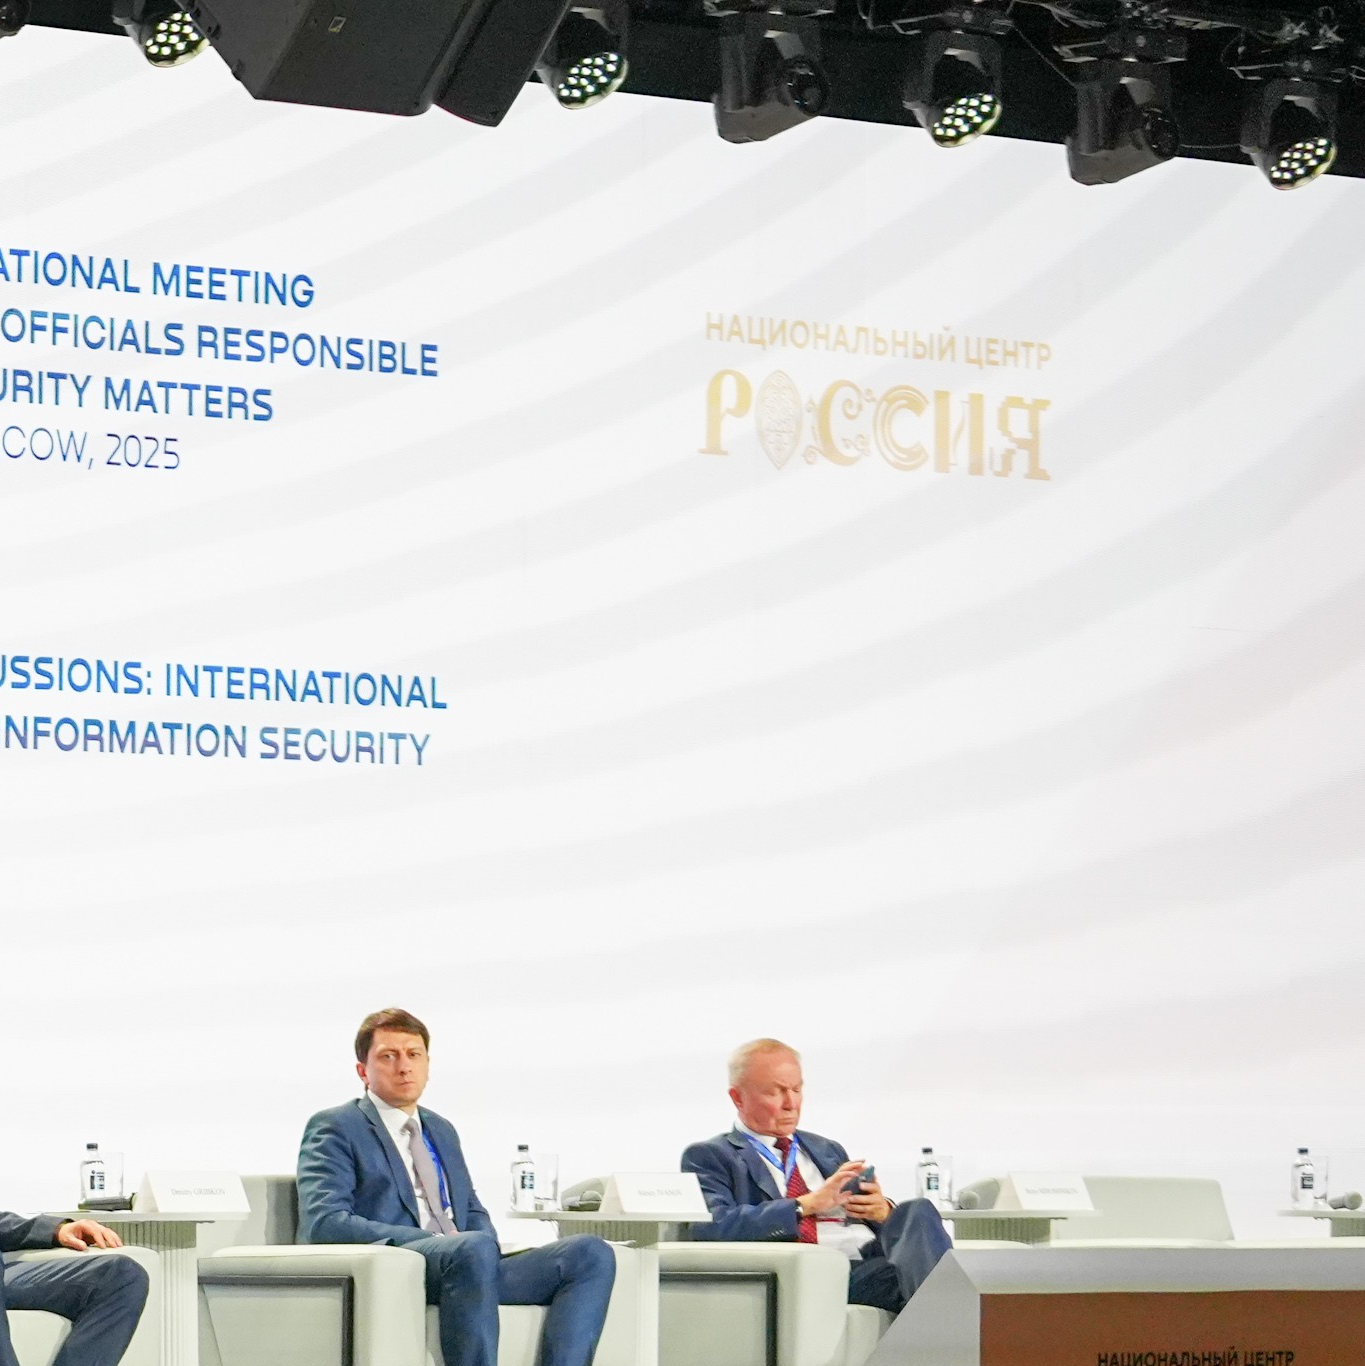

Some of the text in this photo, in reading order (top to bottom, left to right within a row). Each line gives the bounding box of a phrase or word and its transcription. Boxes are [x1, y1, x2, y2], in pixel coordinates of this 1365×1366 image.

[152, 262, 315, 308] MEETING
[1, 308, 185, 356] OFFICIALS
[197, 325, 438, 377] RESPONSIBLE
[705, 311, 1052, 370] НАЦИОНАЛЬНЫЙ ЦЕНТР
[104, 377, 274, 422] MATTERS
[697, 368, 1052, 481] РОССИЯ
[105, 433, 181, 471] 2025
[166, 663, 448, 709] INTERNATIONAL
[260, 727, 429, 764] SECURITY
